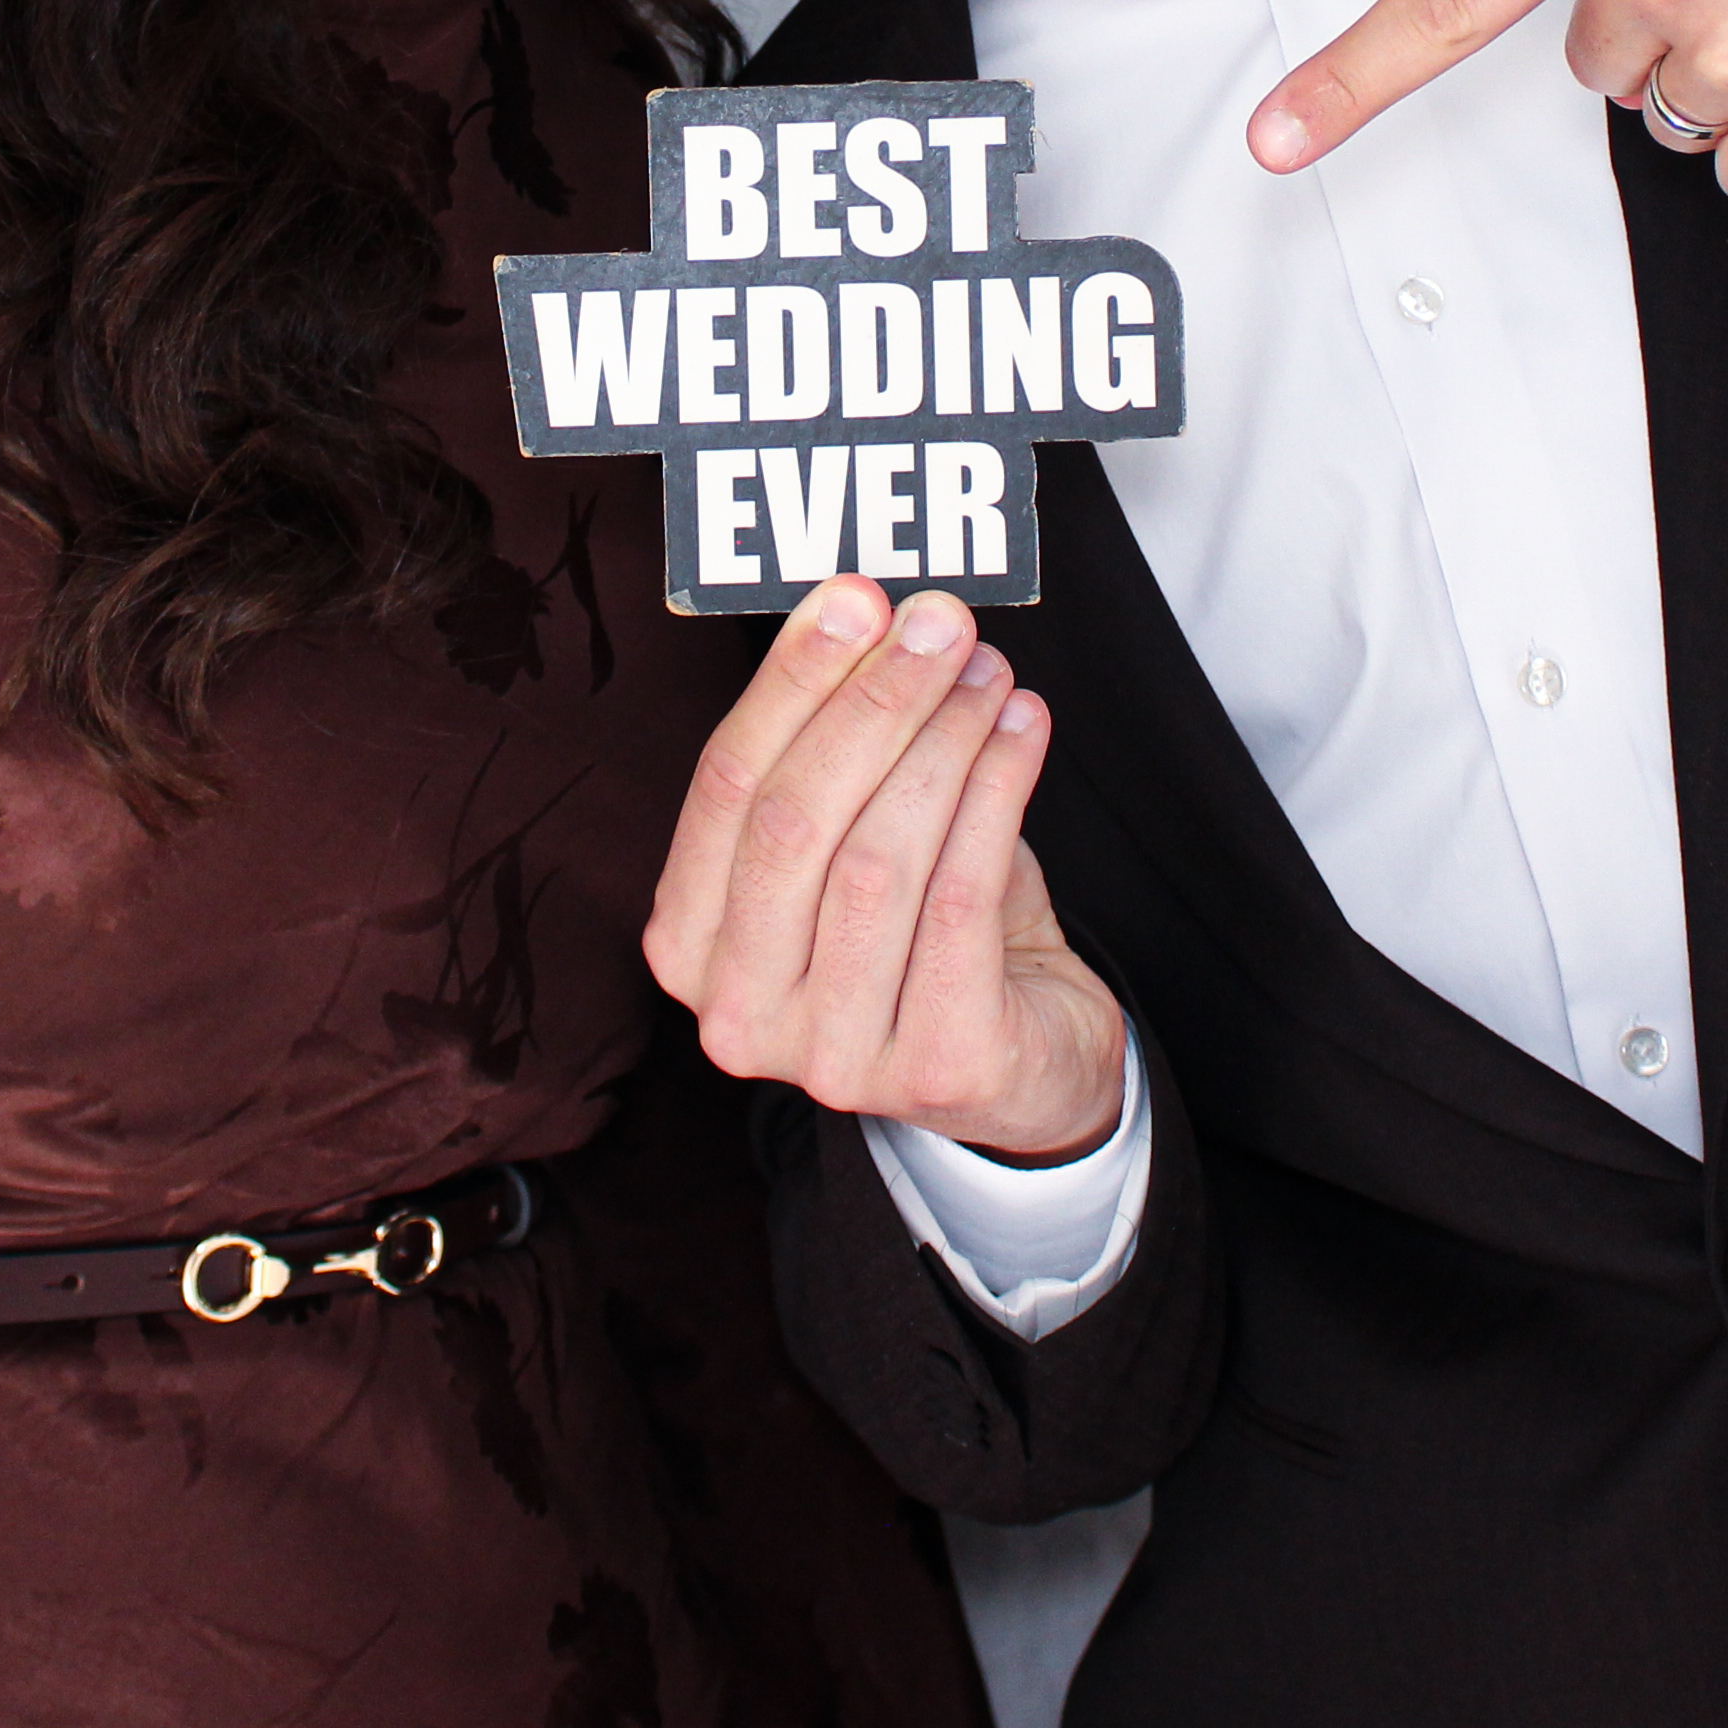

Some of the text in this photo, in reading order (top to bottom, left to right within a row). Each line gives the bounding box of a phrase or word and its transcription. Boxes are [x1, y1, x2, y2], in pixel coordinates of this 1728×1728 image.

[683, 116, 1007, 262] BEST
[531, 272, 1158, 428] WEDDING
[696, 441, 1009, 585] EVER
